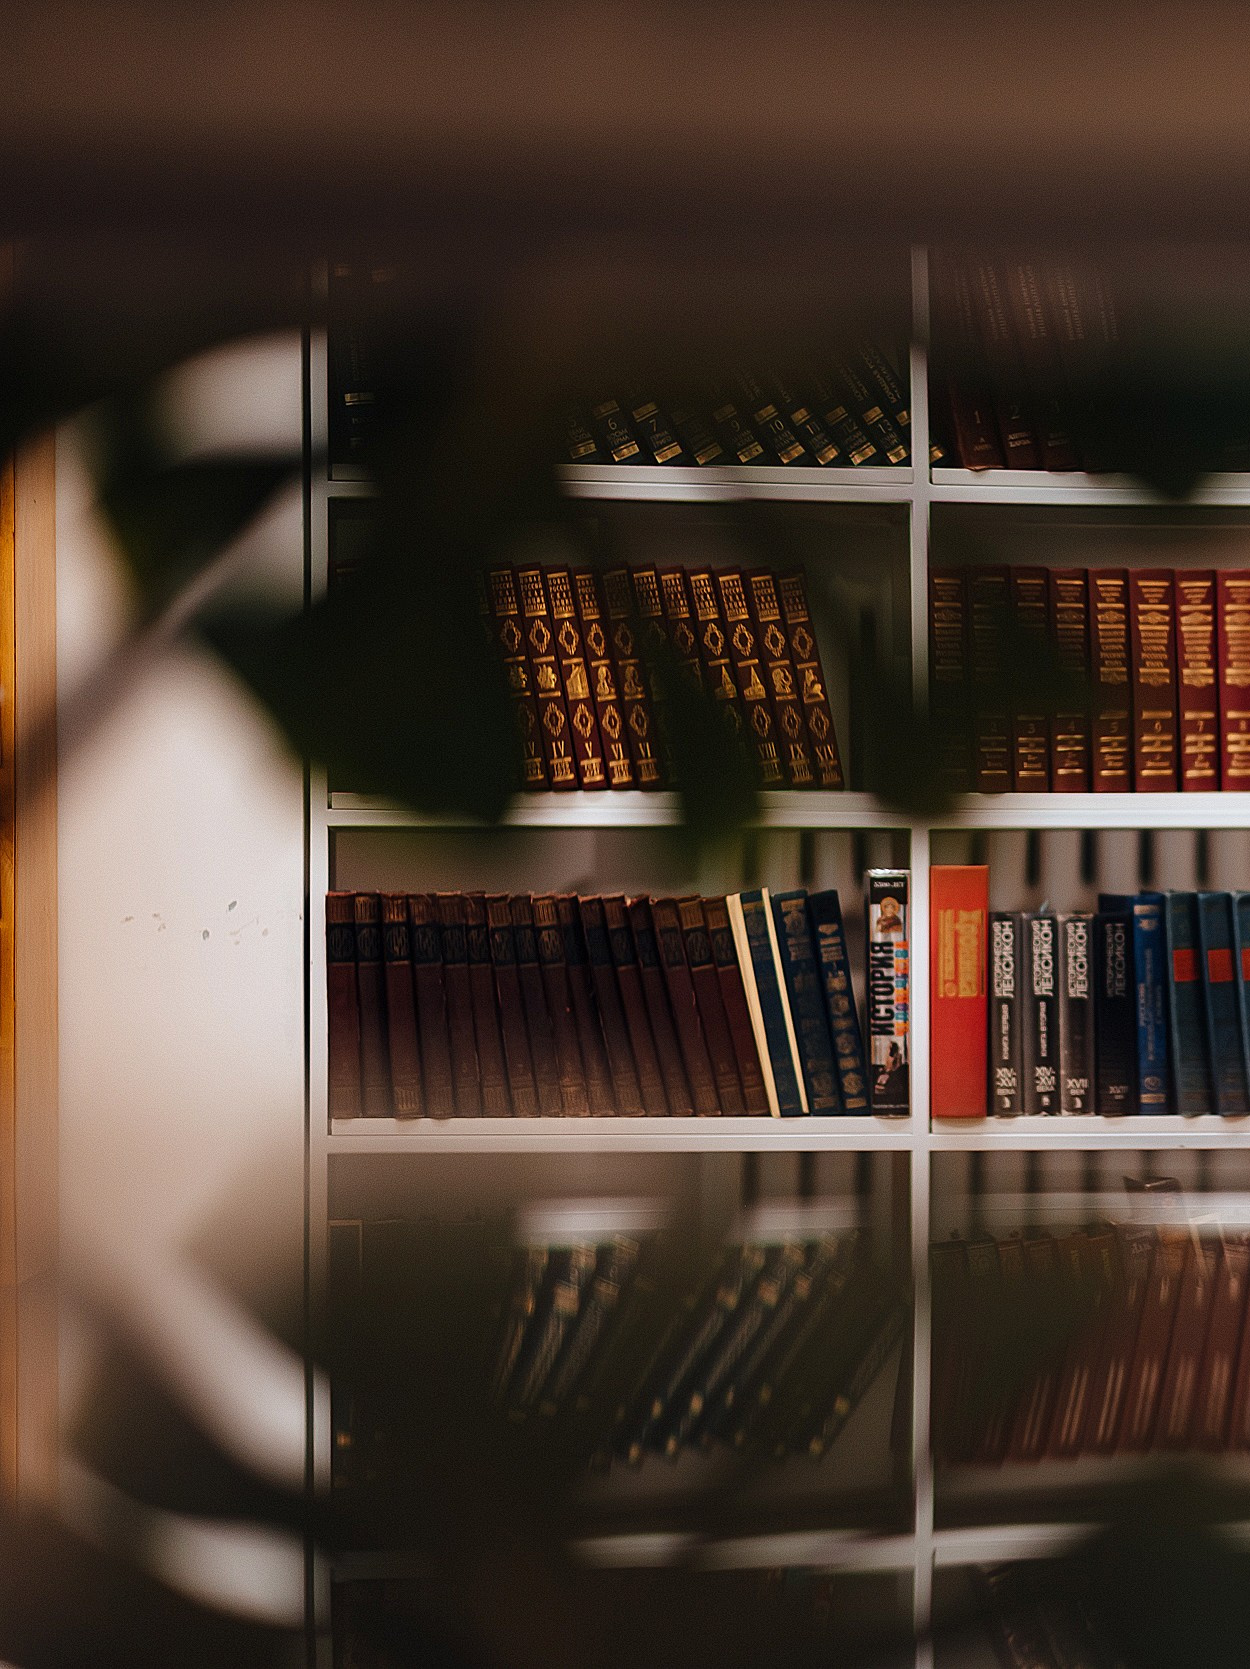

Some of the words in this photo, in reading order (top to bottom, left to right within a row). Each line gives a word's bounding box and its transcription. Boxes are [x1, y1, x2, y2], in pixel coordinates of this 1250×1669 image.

[607, 417, 617, 430] 6
[648, 417, 657, 432] 7
[769, 418, 784, 434] 10
[551, 740, 566, 759] IV
[584, 740, 592, 758] V
[610, 742, 624, 759] VI
[789, 743, 805, 760] IX
[871, 942, 894, 1036] ИСТОРИЯ
[993, 921, 1003, 998] ИСТОРИЧЕСКИЙ
[1001, 921, 1015, 999] ЛЕКСИКОН
[1032, 920, 1042, 996] ИСТОРИЧЕСКИЙ
[1040, 919, 1054, 997] ЛЕКСИКОН
[1067, 922, 1076, 997] ИСТОРИЧЕСКИЙ
[1074, 921, 1088, 999] ЛЕКСИКОН
[1105, 923, 1114, 998] ИСТОРИЧЕСКИЙ
[1113, 923, 1126, 997] ЛЕКСИКОН
